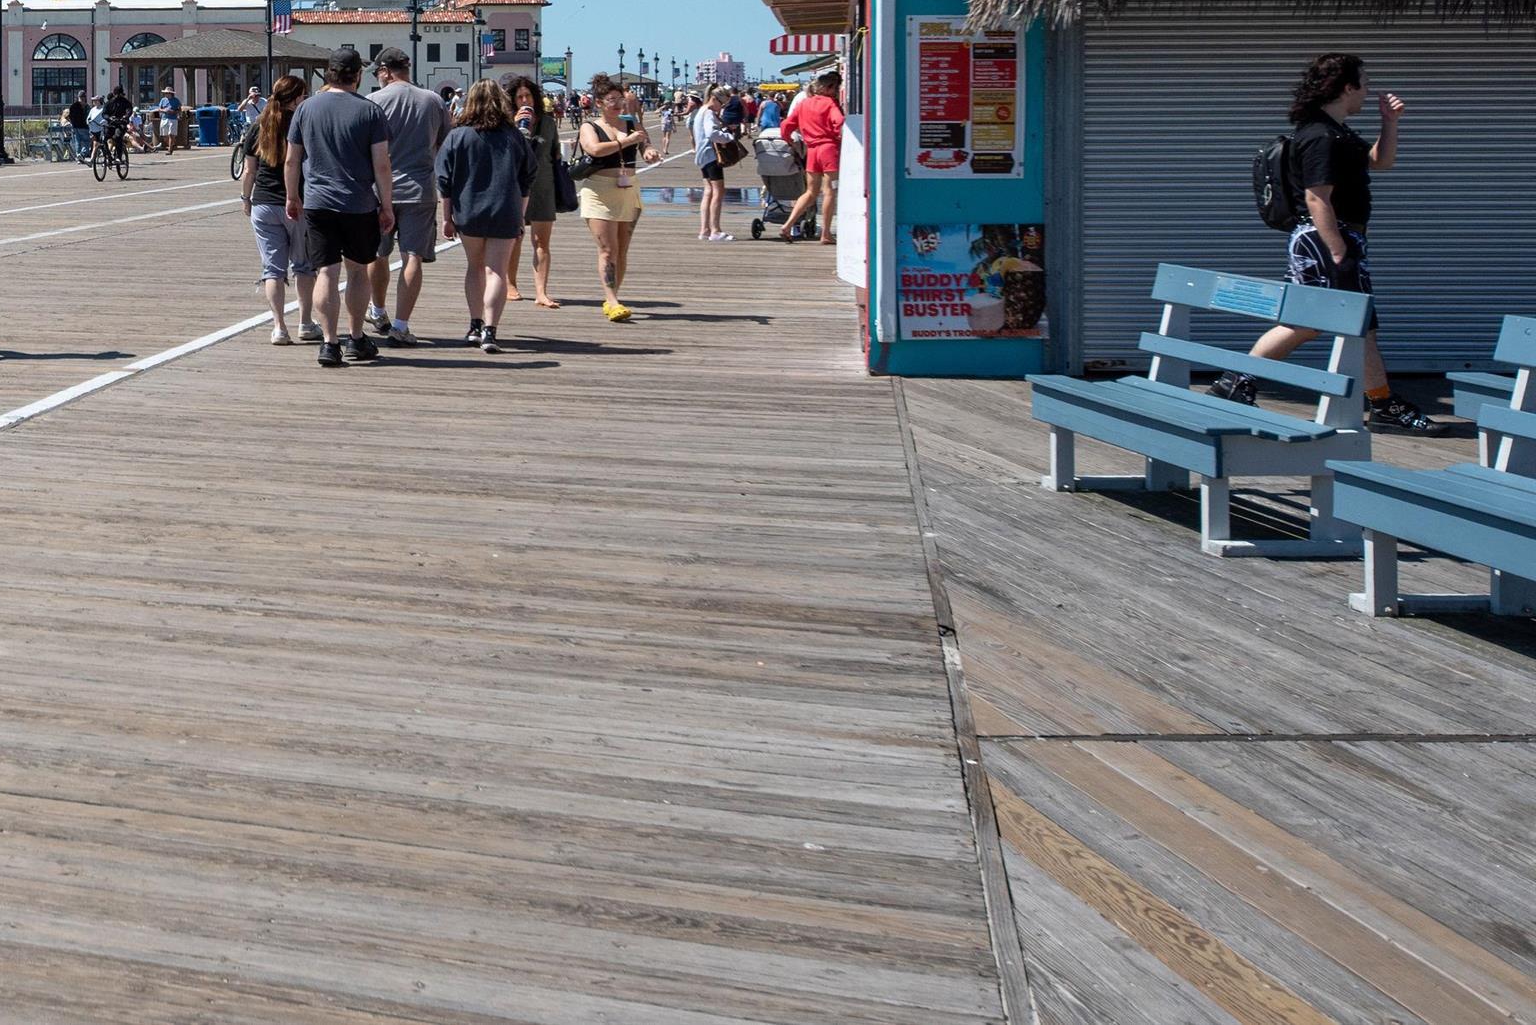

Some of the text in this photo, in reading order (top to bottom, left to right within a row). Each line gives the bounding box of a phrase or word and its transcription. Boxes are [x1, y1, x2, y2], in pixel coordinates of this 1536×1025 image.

[912, 231, 941, 253] YES!
[901, 273, 980, 287] BUDDY'S
[903, 288, 966, 302] THIRST
[903, 304, 973, 317] BUSTER
[911, 330, 951, 338] BUDDY'S
